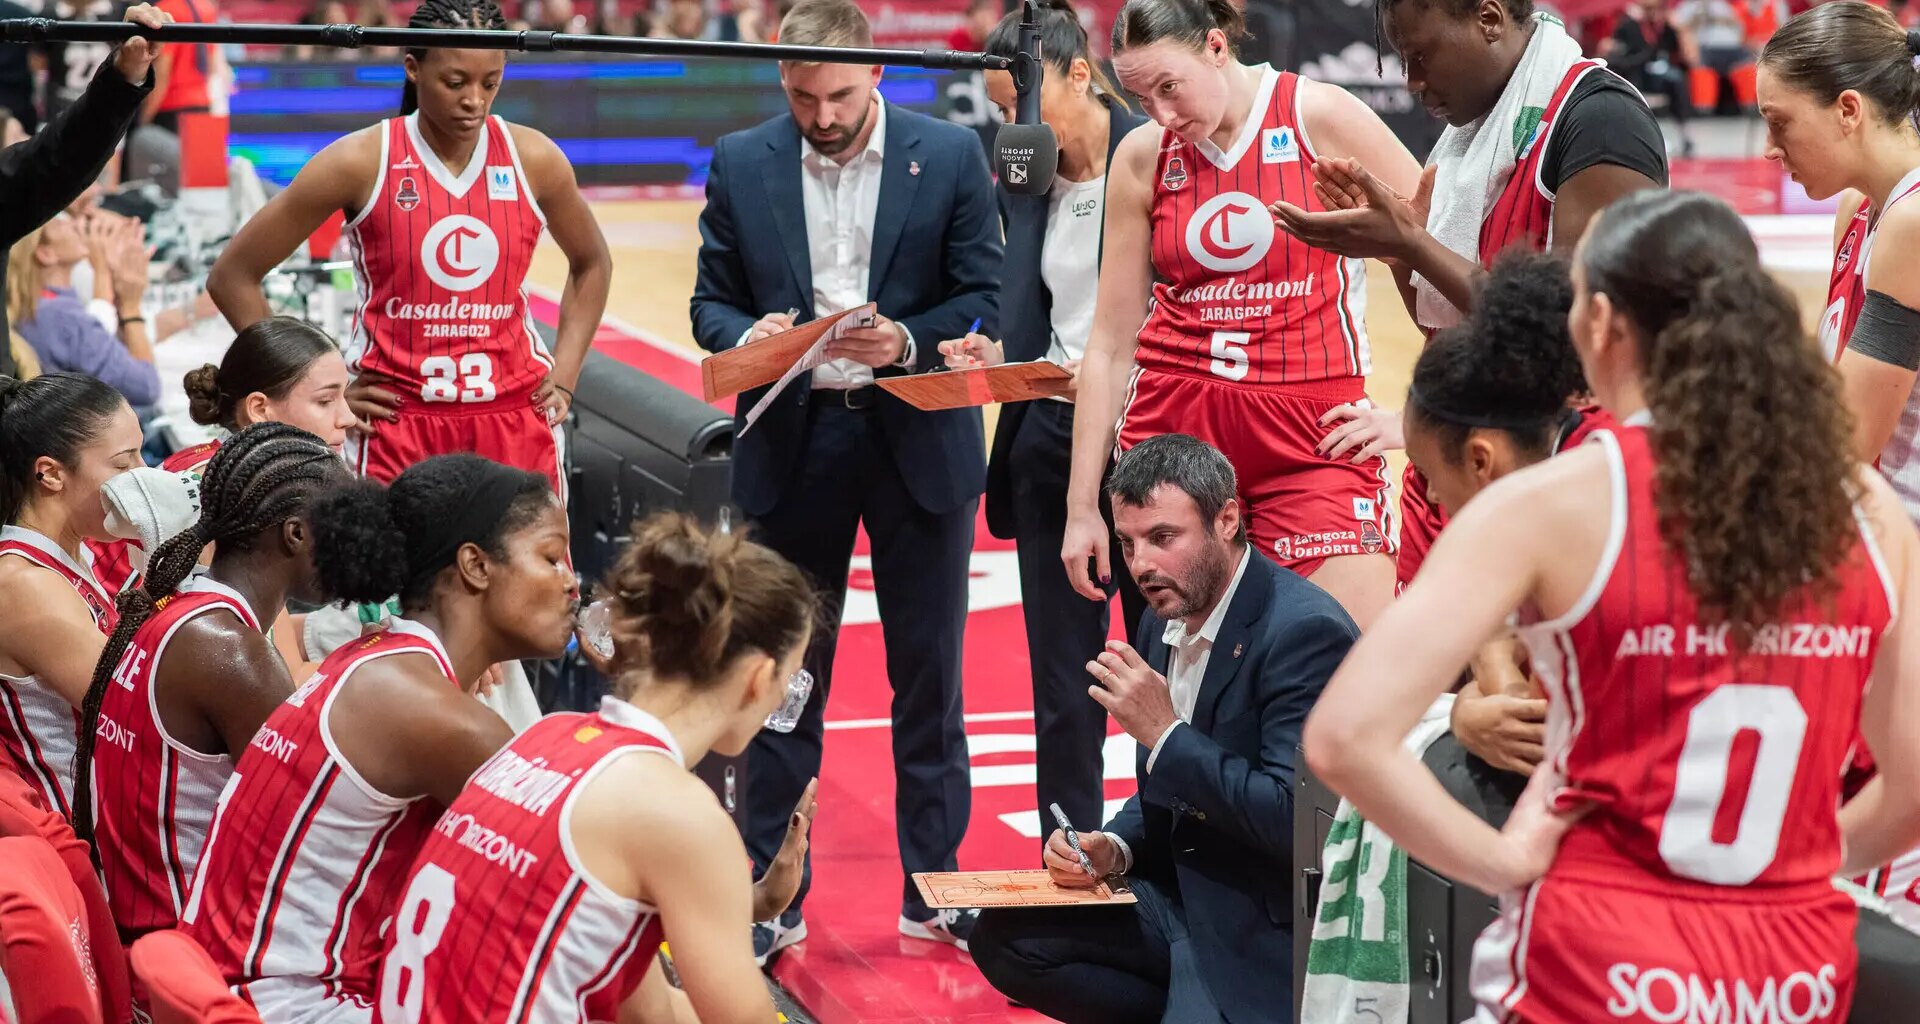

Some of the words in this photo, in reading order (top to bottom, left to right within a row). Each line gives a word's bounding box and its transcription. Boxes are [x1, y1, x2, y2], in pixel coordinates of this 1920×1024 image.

[385, 296, 516, 320] Casademon
[1200, 304, 1273, 322] ZARAGOZA
[423, 324, 491, 338] ZARAGOZA
[1210, 331, 1251, 381] 5
[1294, 531, 1357, 546] Zaragoza
[1614, 622, 1676, 661] AIR
[1658, 683, 1809, 886] 0
[379, 861, 456, 1024] 8
[1606, 961, 1837, 1024] SOMMOS
